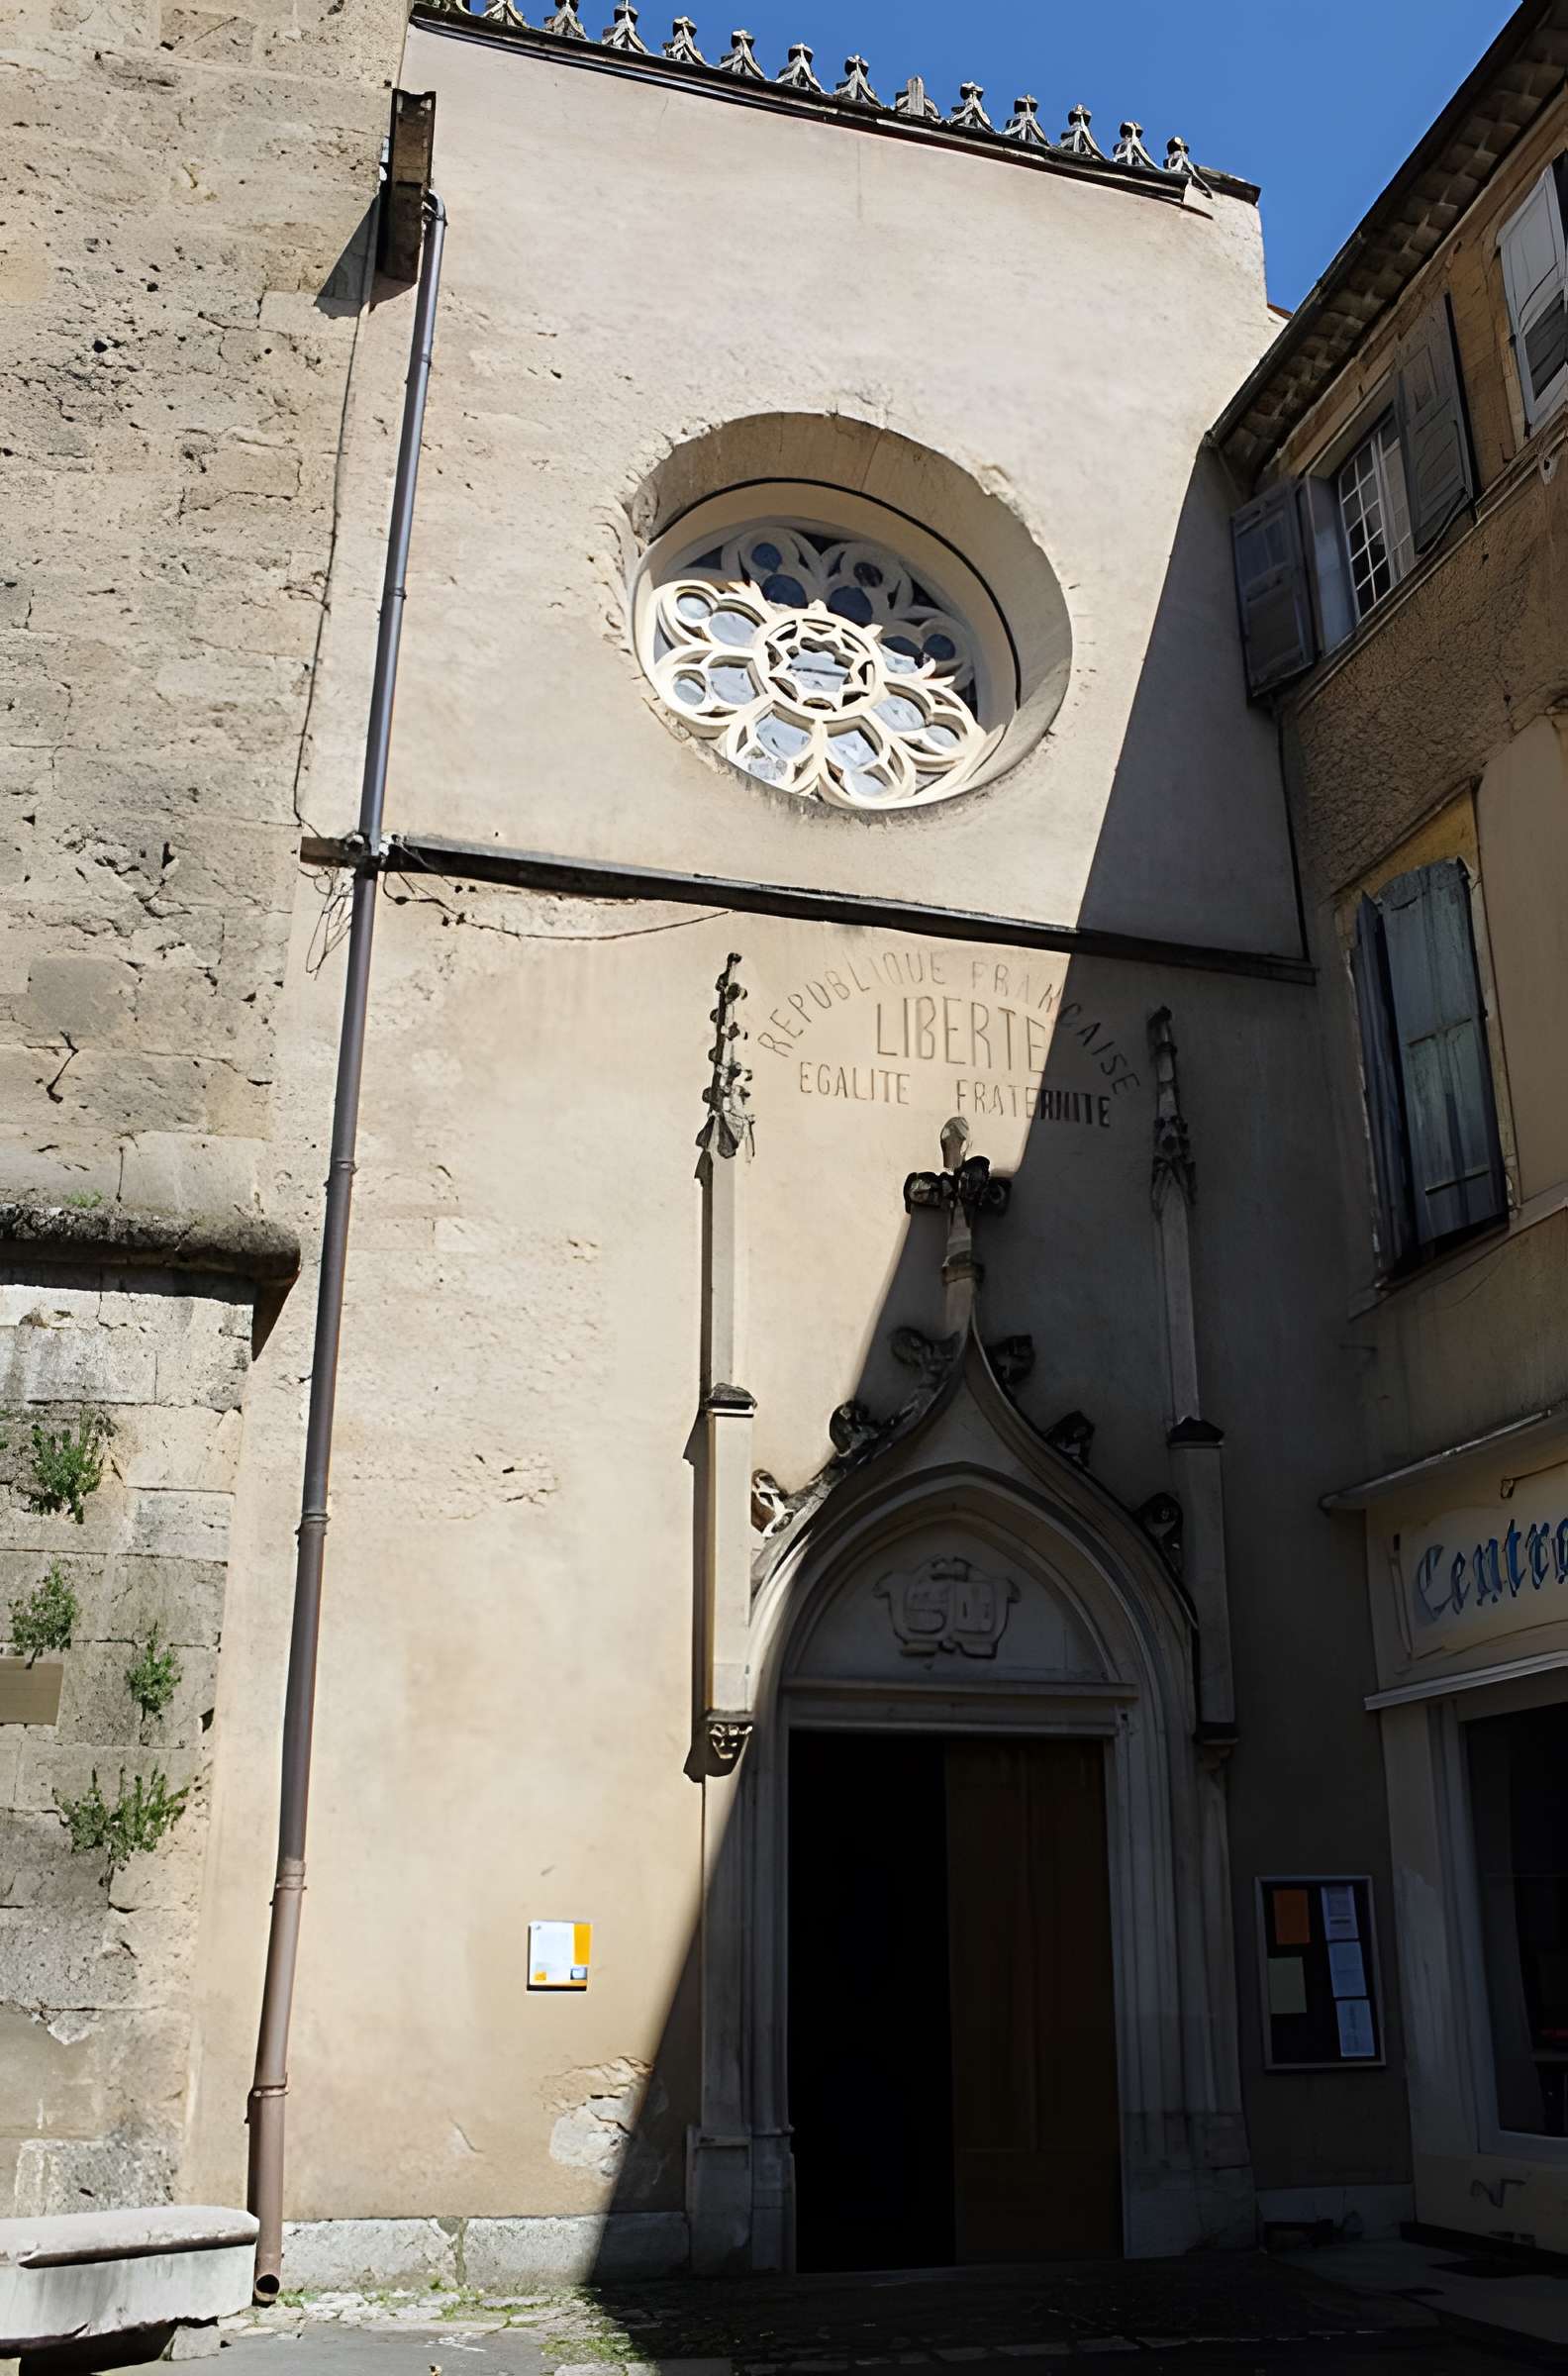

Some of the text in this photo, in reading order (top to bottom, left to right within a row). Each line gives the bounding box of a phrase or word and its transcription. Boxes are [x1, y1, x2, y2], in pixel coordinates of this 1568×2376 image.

[756, 950, 946, 1057] REPUBLIQUE
[876, 996, 1045, 1073] LIBERTE
[799, 1061, 911, 1106] EGALITE
